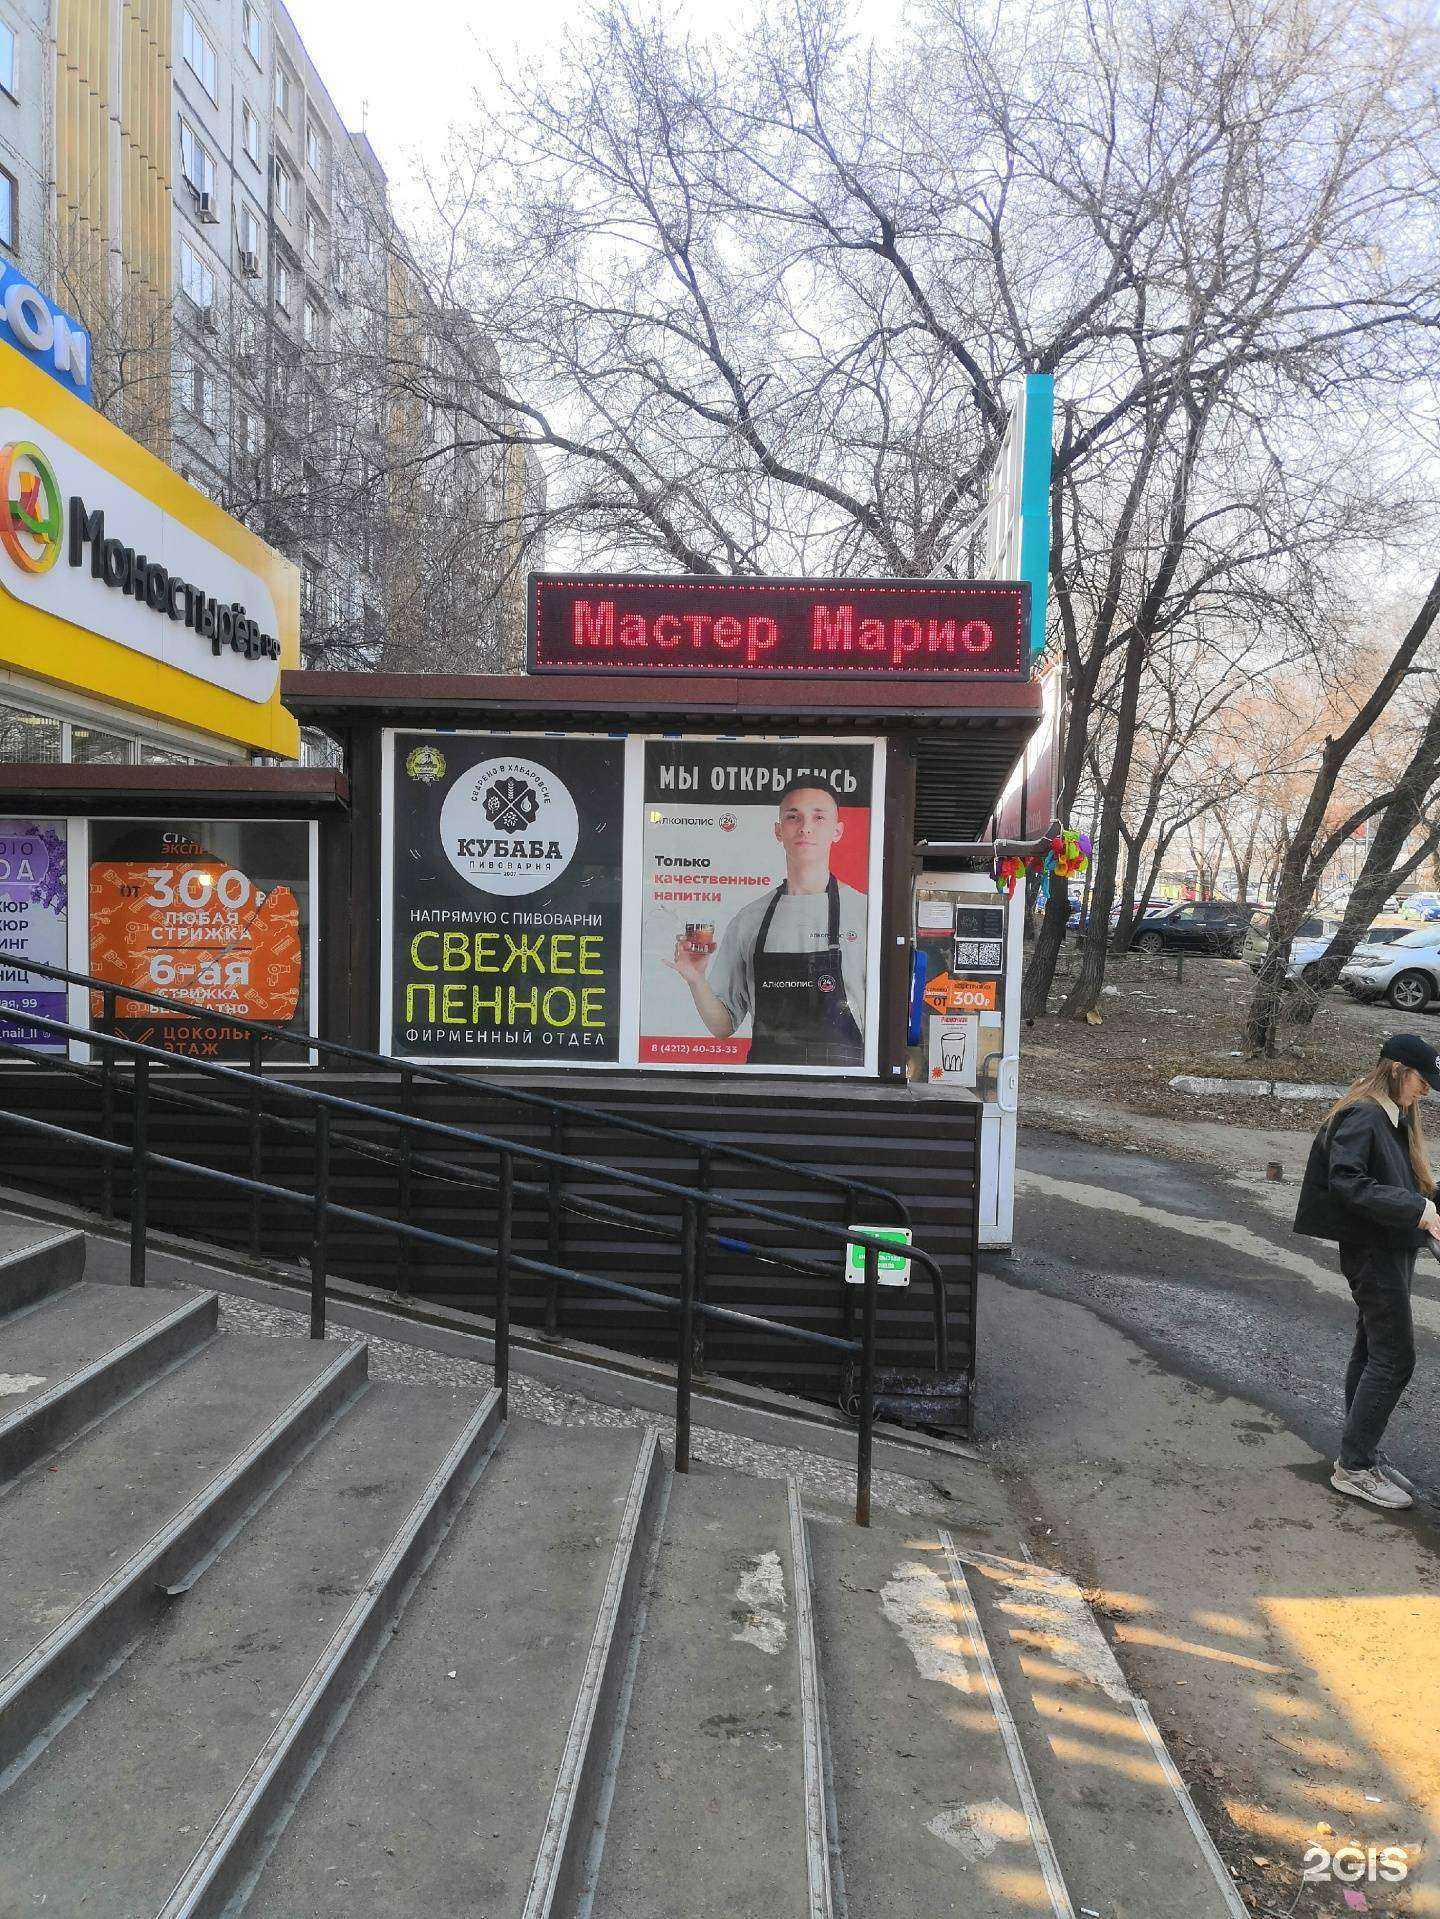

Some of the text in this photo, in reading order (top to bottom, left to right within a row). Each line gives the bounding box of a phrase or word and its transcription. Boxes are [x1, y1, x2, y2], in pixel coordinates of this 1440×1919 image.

[0, 260, 87, 386] ON
[573, 600, 994, 664] Мастер Марио
[660, 765, 698, 790] МЫ
[457, 839, 563, 859] КУБАБА
[470, 861, 551, 870] ПИВОВАРНЯ
[655, 855, 711, 868] Только
[654, 874, 771, 886] качественные
[654, 892, 721, 902] напитки
[164, 911, 240, 925] ЛЮБАЯ
[410, 910, 603, 926] НАПРЯМУЮ С ПИВОВАРНИ
[151, 927, 252, 941] СТРИЖКА
[410, 930, 605, 975] СВЕЖЕЕ
[0, 970, 29, 984] ИЦ
[150, 954, 249, 986] 6-ая
[157, 987, 240, 1000] СТРИЖКА
[22, 998, 38, 1008] 99
[406, 983, 607, 1027] ПЕННОЕ
[406, 1028, 604, 1046] ФИРМЕННЫЙ ОТДЕЛ
[660, 1044, 690, 1054] (4212)
